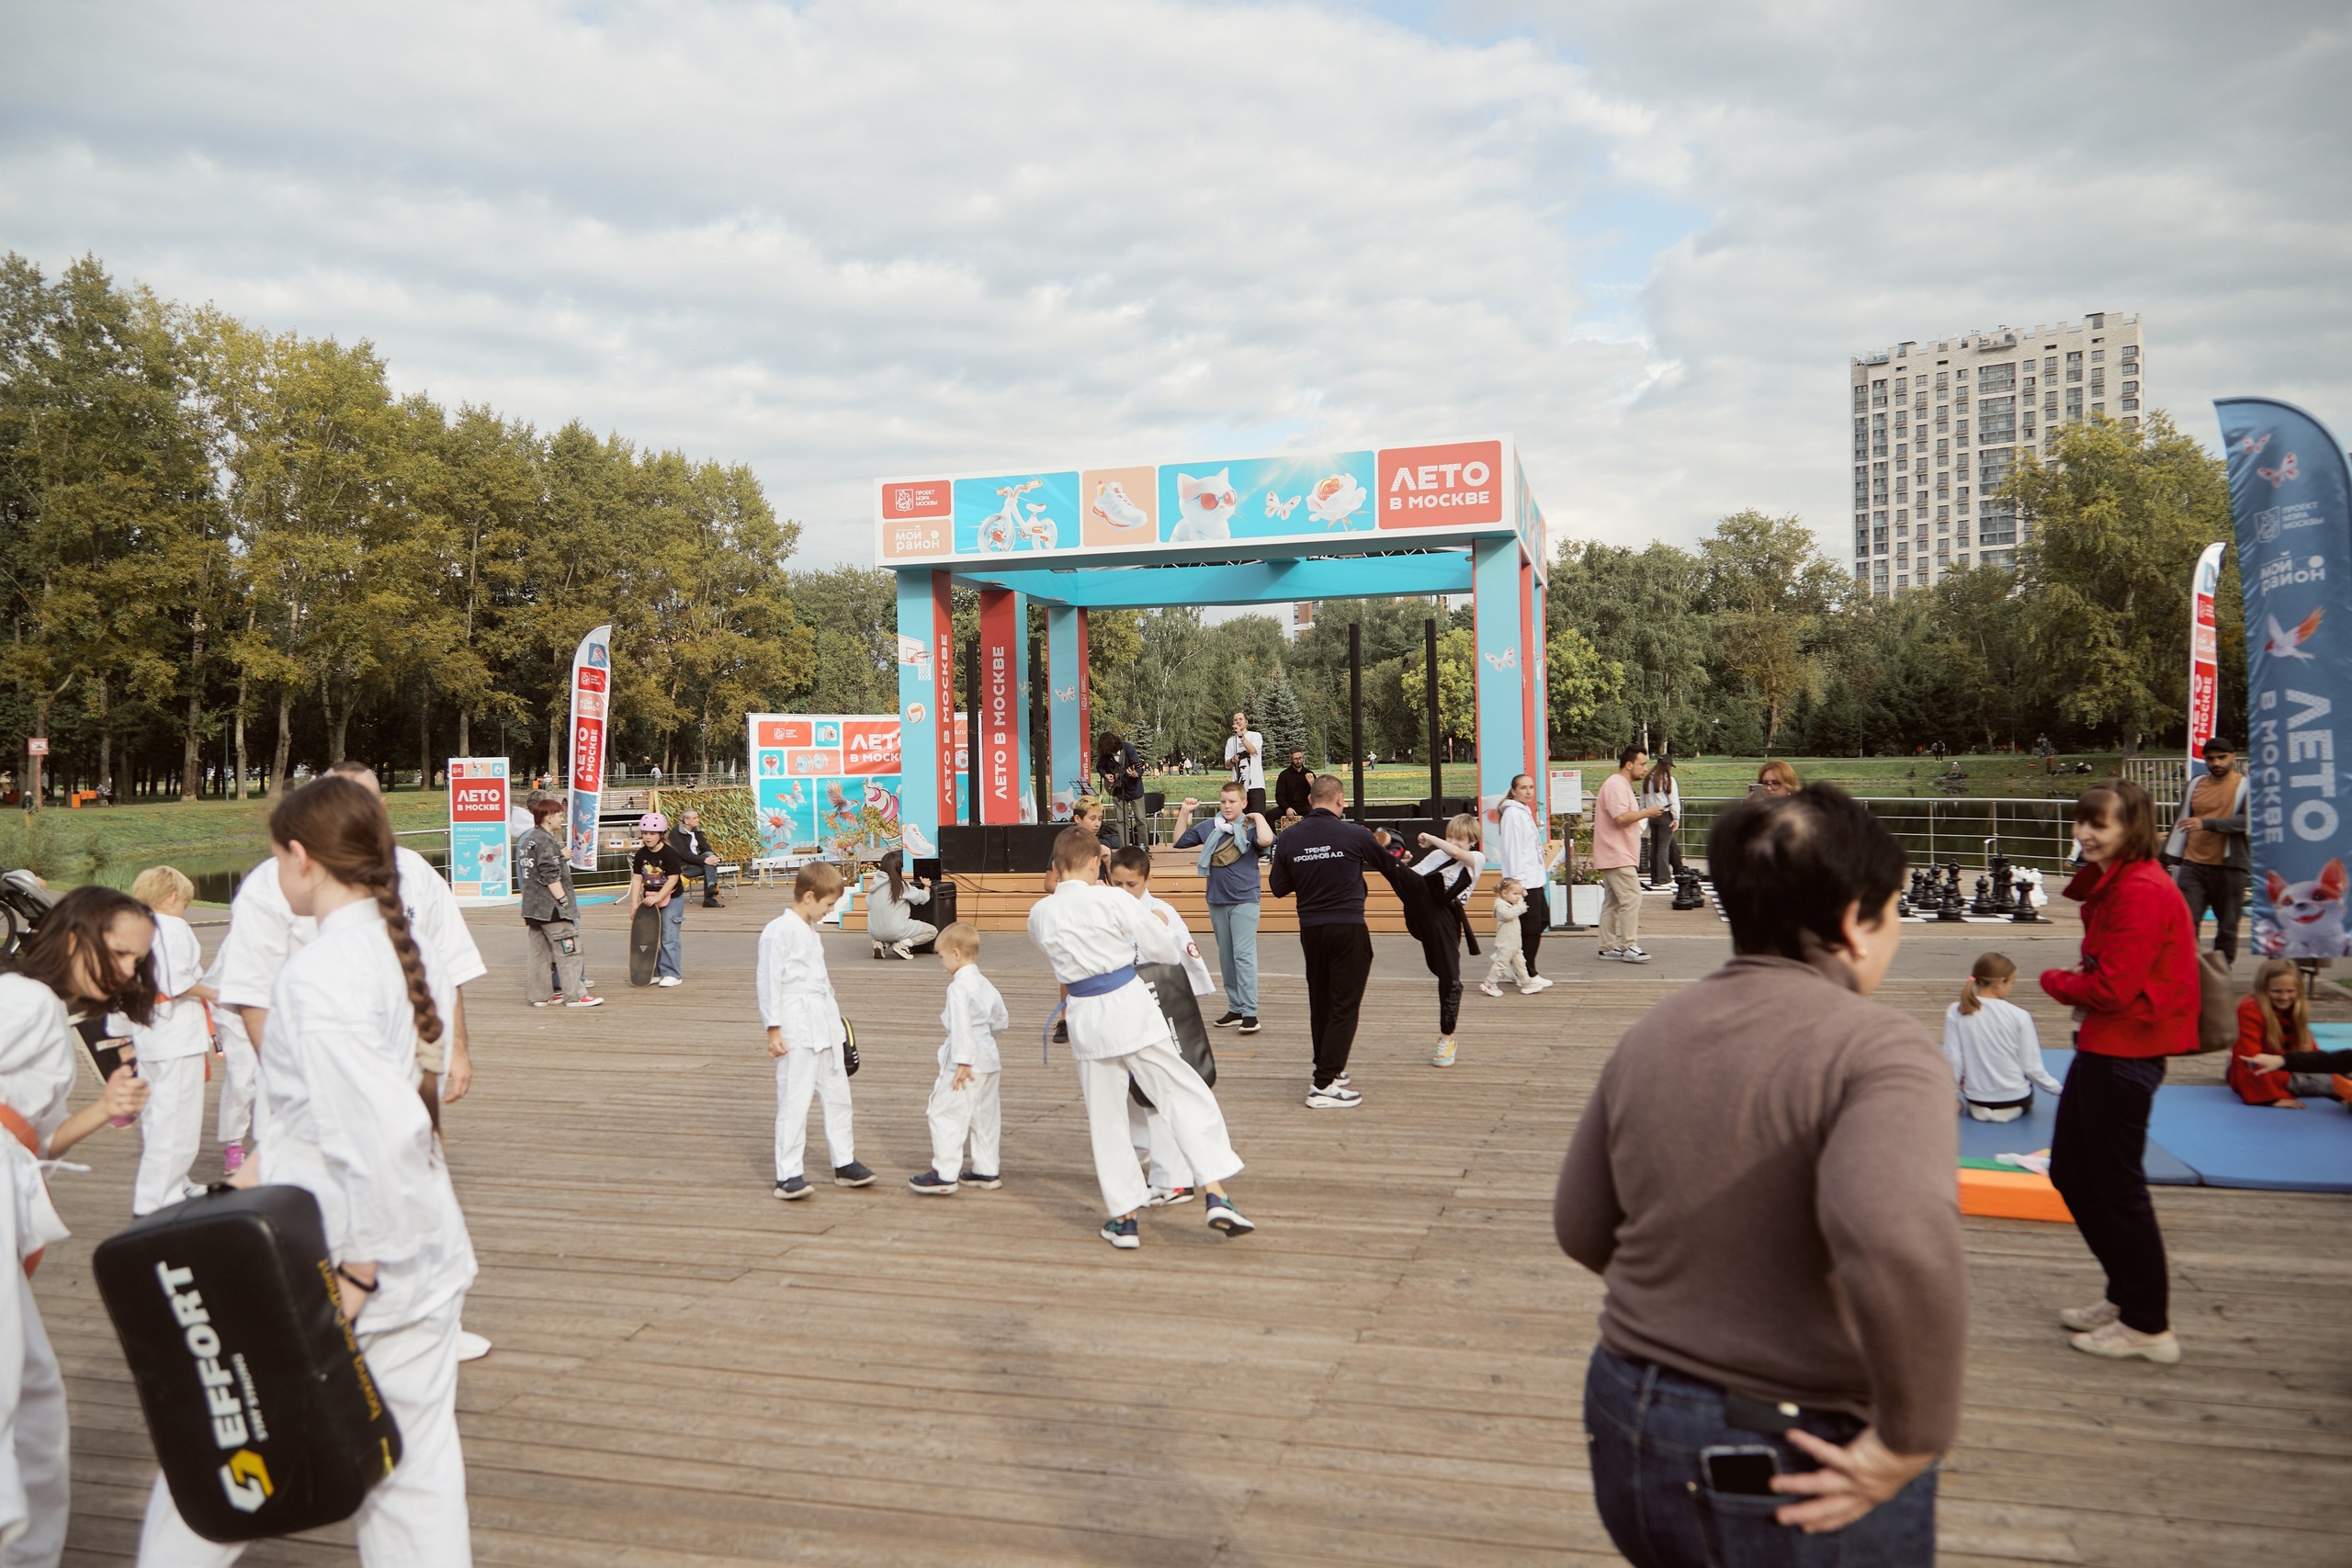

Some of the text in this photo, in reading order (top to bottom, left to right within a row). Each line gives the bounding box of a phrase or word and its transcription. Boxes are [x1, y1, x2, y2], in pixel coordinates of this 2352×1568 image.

[1390, 461, 1490, 492] ЛЕТО
[1390, 491, 1490, 510] В МОСКВЕ
[2282, 501, 2319, 513] ПРОЕКТ
[2282, 511, 2310, 522] МЭРА
[2282, 516, 2324, 530] МОСКВЫ
[941, 634, 952, 805] ЛЕТО В МОСКВЕ
[2199, 676, 2212, 733] МОСКВЕ
[992, 646, 1008, 800] ЛЕТО В МОСКВЕ
[577, 727, 589, 780] ЛЕТО
[586, 728, 598, 772] МОСКВЕ
[851, 734, 900, 750] ЛЕТ
[851, 752, 901, 762] В МОСК
[2260, 690, 2284, 843] В МОСКВЕ
[2285, 689, 2339, 841] ЛЕТО
[457, 789, 500, 802] ЛЕТО
[1304, 845, 1331, 854] ТРЕНЕР
[155, 1260, 249, 1450] EFFORT
